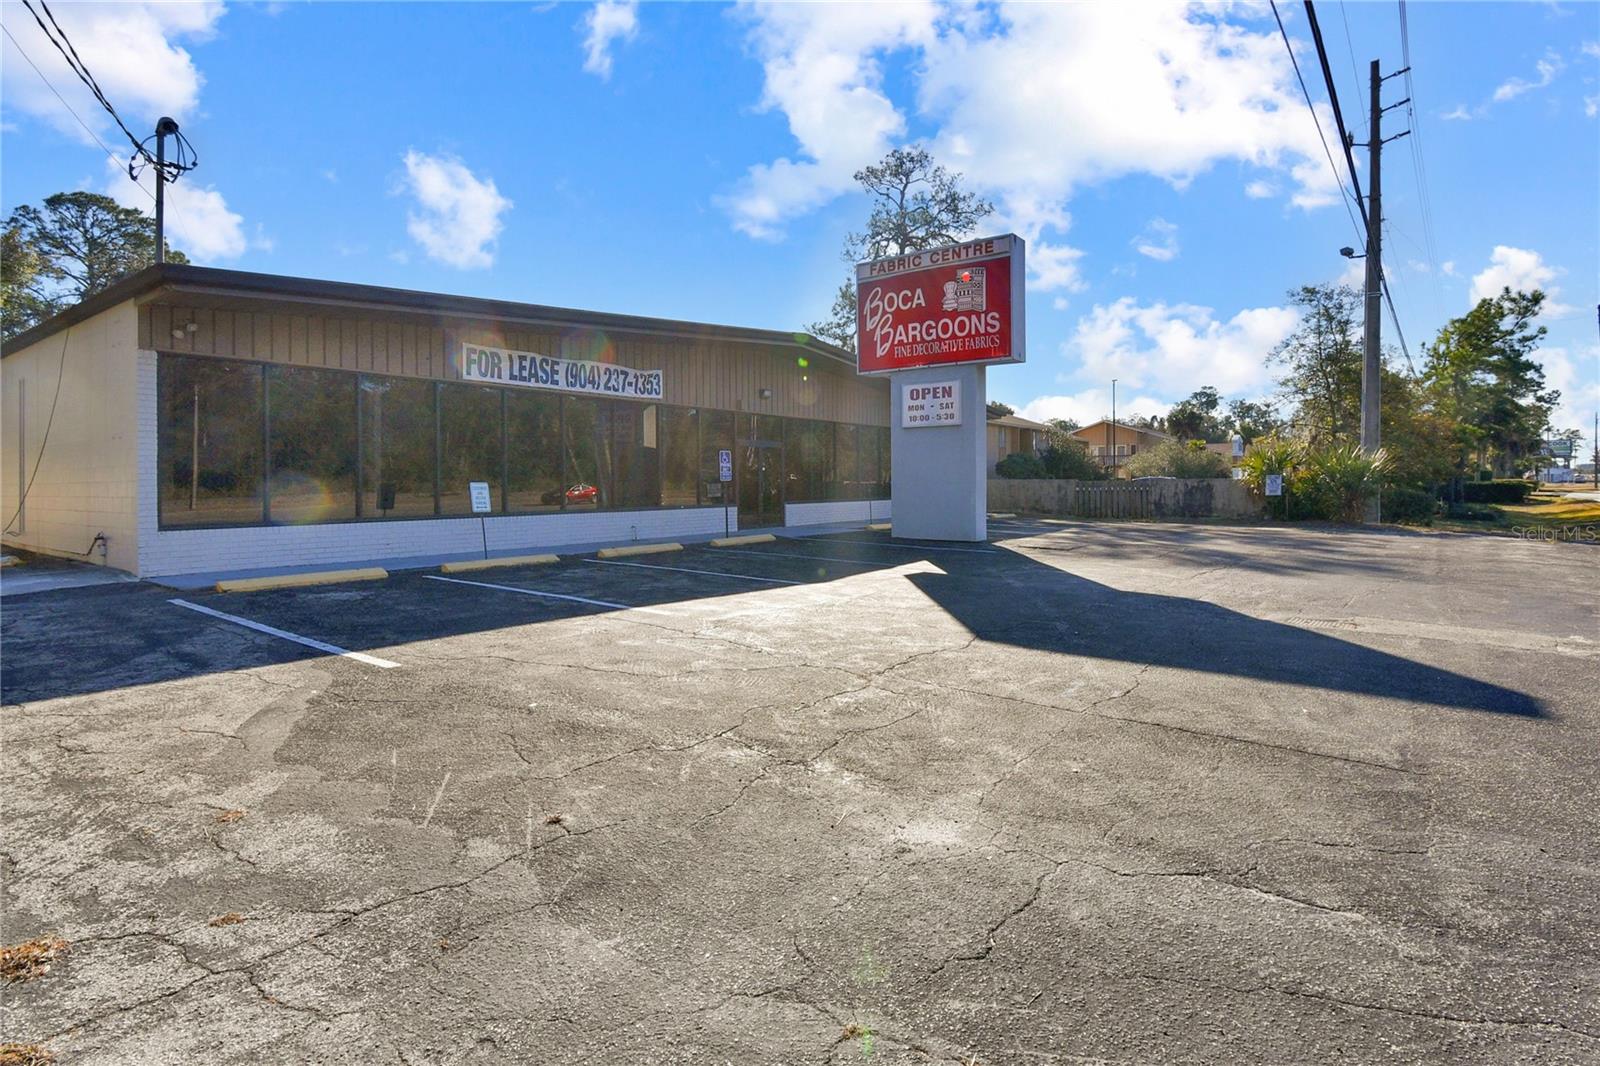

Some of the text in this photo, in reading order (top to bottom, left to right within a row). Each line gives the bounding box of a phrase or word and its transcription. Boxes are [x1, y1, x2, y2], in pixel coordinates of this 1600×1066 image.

[869, 240, 994, 276] FABRIC CENTRE
[864, 286, 926, 332] BOCA
[874, 311, 1000, 358] BARGOONS
[894, 334, 1000, 359] FINE DECORATIVE FABRICS
[465, 347, 661, 396] FOR LEASE (904) 237-1353
[907, 404, 925, 412] MON
[939, 402, 955, 410] SAT
[909, 385, 953, 401] OPEN
